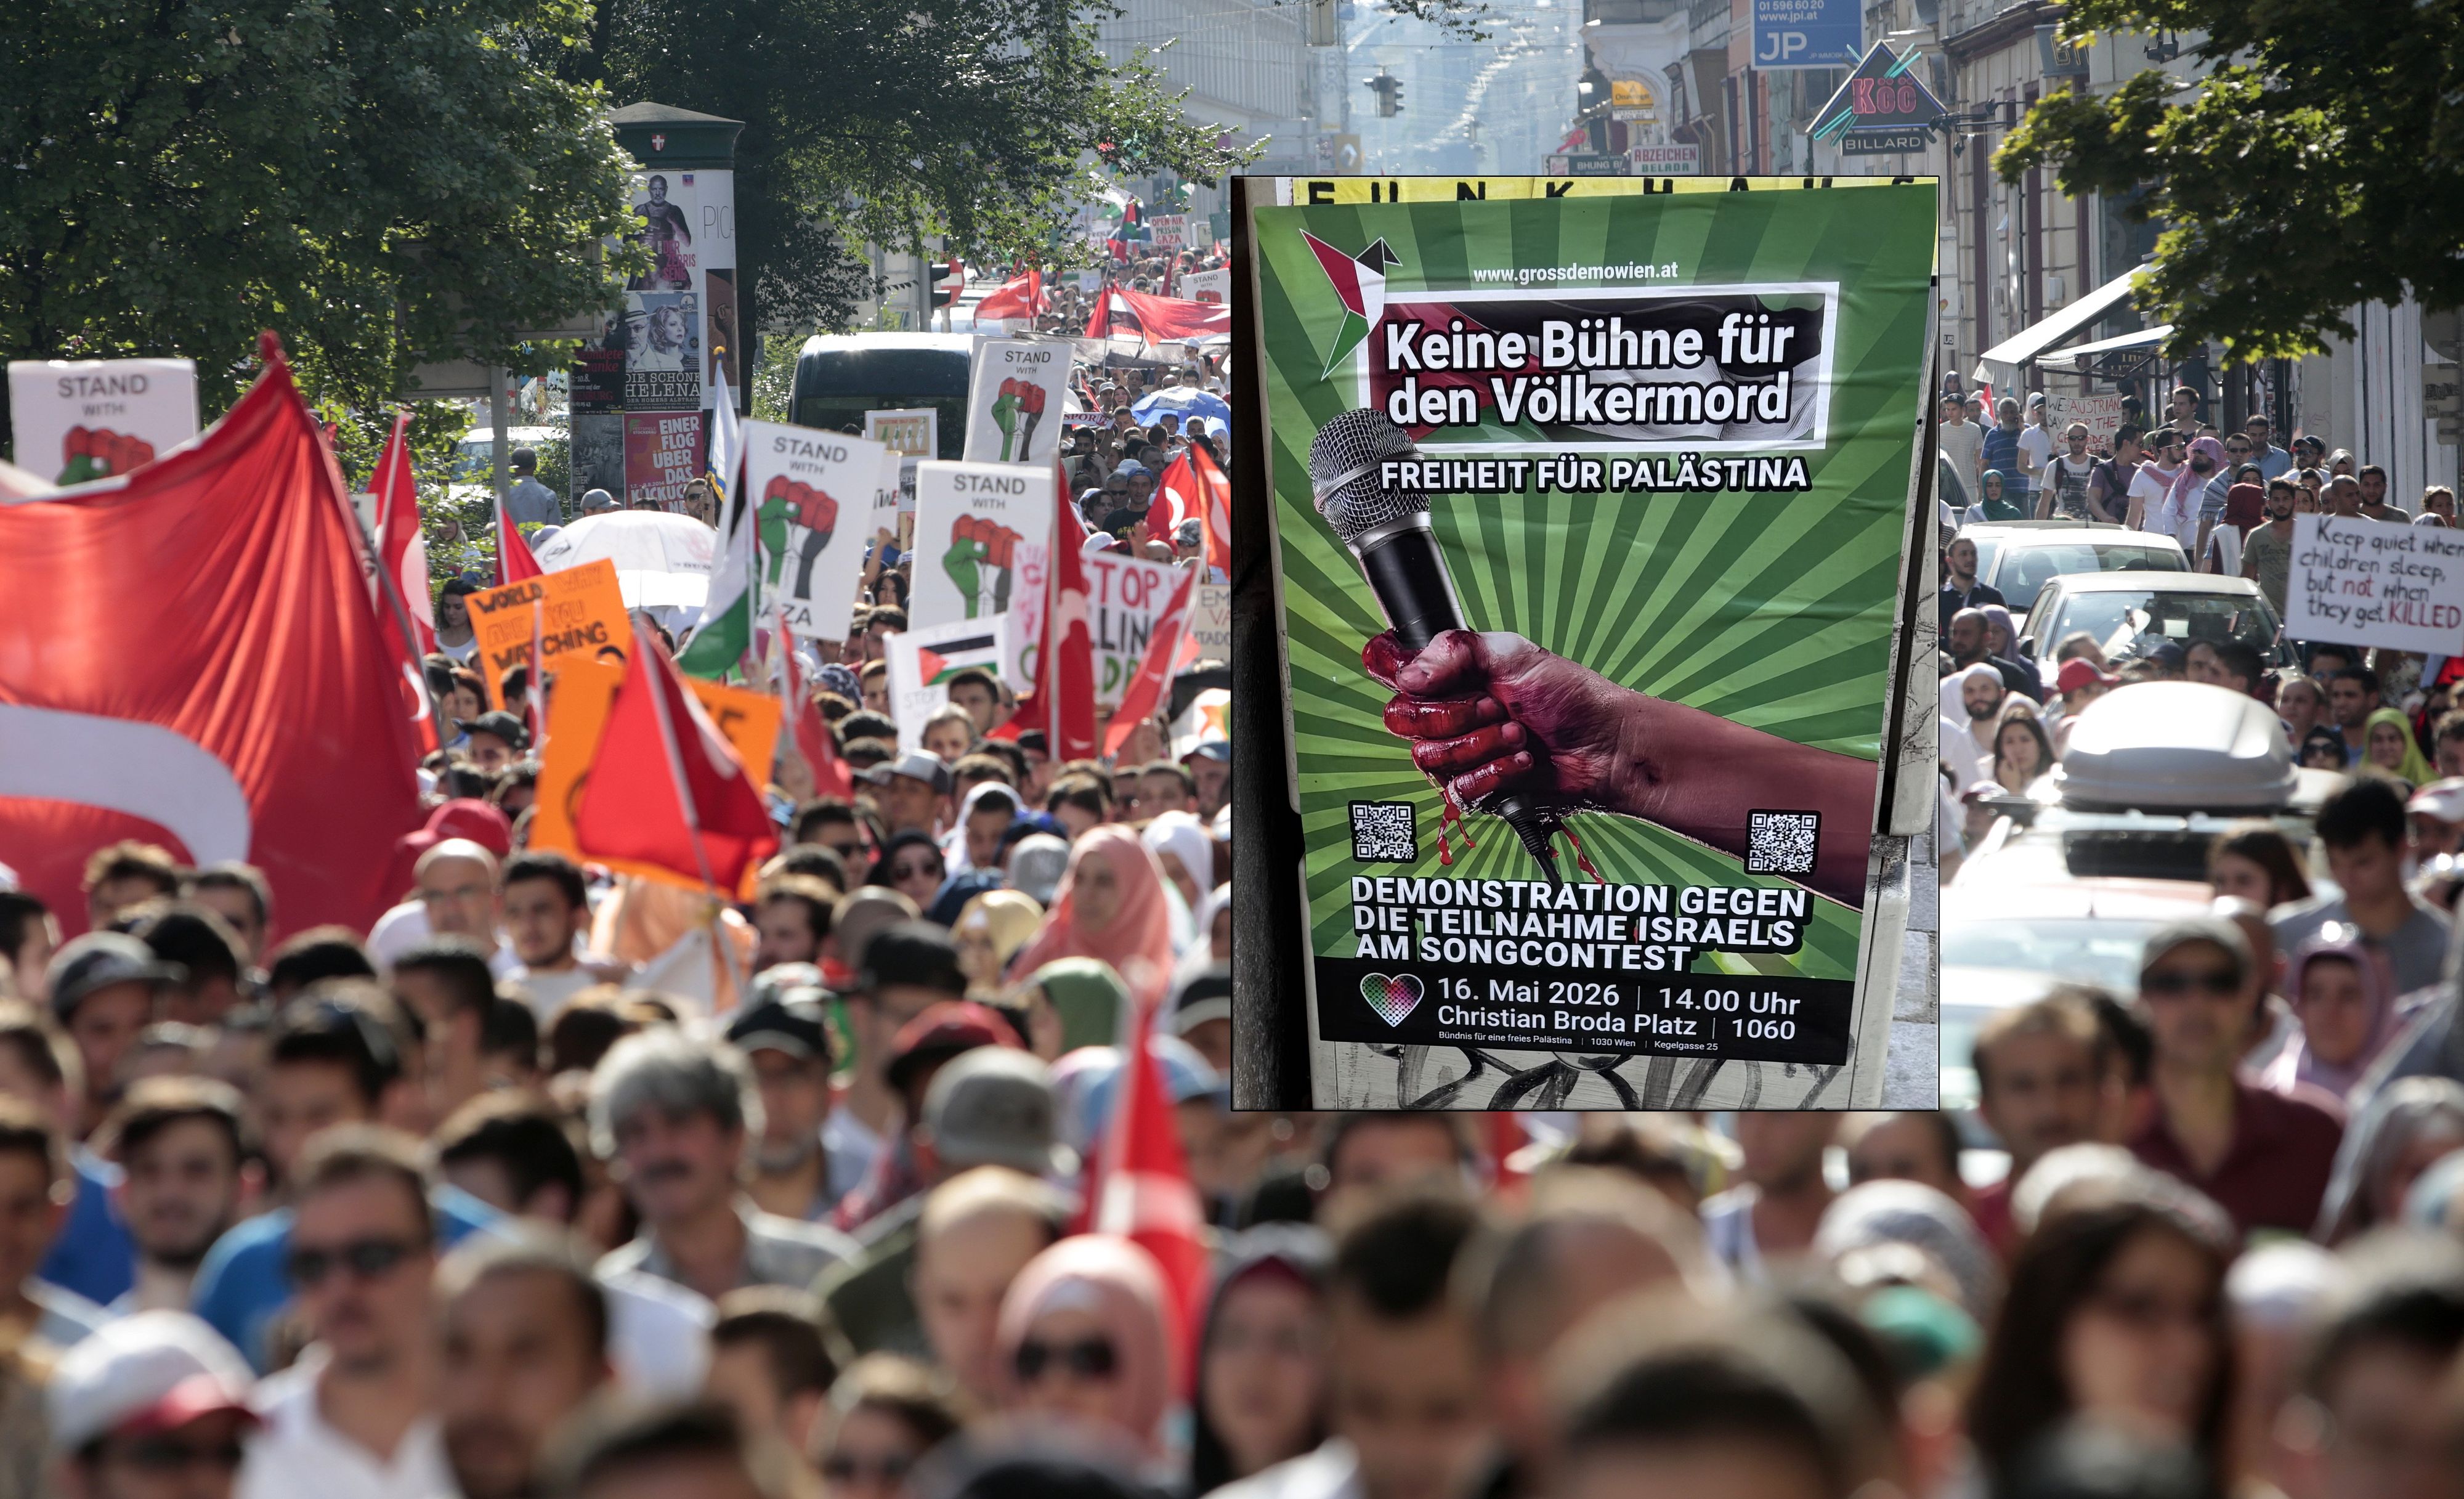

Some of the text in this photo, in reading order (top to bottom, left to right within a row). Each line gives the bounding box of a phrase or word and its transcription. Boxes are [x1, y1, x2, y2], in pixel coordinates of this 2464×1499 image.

[1759, 0, 1825, 10] 01 596 60 20
[1759, 10, 1818, 23] www.jpi.at
[1759, 32, 1807, 60] JP
[1846, 137, 1921, 150] BILLARD
[1635, 147, 1697, 161] ABZEICHEN
[1642, 163, 1690, 172] BELADA
[1156, 225, 1181, 235] PRISON
[663, 240, 680, 254] DER
[1156, 235, 1181, 245] GAZA
[667, 254, 696, 267] ZERRIS
[1193, 274, 1218, 284] STAND
[1473, 261, 1679, 285] www.grossdemowien.at
[1386, 314, 1794, 370] Keine Bühne für
[1005, 350, 1051, 364] STAND
[626, 370, 700, 383] DIE SCHÖNE
[1016, 366, 1037, 375] WITH
[57, 373, 149, 399] STAND
[625, 383, 700, 397] HELENA
[1389, 371, 1788, 424] den Völkermord
[83, 402, 127, 418] WITH
[659, 416, 700, 435] EINER
[2096, 416, 2119, 429] THE
[661, 433, 695, 450] FLOG
[2057, 432, 2105, 444] GEIDE
[652, 449, 693, 468] ÜBER
[772, 436, 848, 463] STAND
[665, 466, 694, 485] DAS
[789, 460, 825, 475] WITH
[1381, 452, 1808, 490] FREIHEIT FÜR PALÄSTINA
[631, 483, 686, 504] KCKUC
[954, 473, 1026, 495] STAND
[971, 497, 1007, 510] WITH
[2316, 517, 2365, 553] Keep
[2372, 532, 2416, 555] quiet
[2299, 547, 2446, 587] children sleep,
[554, 565, 603, 593] WHY
[2306, 569, 2430, 602] but not when
[760, 603, 813, 627] AZA
[2308, 594, 2462, 629] they get KILLED
[487, 599, 584, 648] ARE YOU
[492, 621, 608, 670] WACHING
[1352, 877, 1806, 917] DEMONSTRATION GEGEN
[1355, 907, 1794, 946] DIE TEILNAHME ISRAELS
[1356, 934, 1692, 972] AM SONGCONTEST
[1438, 978, 1801, 1015] 16. Mai 2026 14.00 Uhr
[1438, 1005, 1796, 1040] Christian Broda Platz 1060
[1438, 1031, 1719, 1051] Bündnis für eine freies Palästina 1030 Wien Kegelgasse 25
